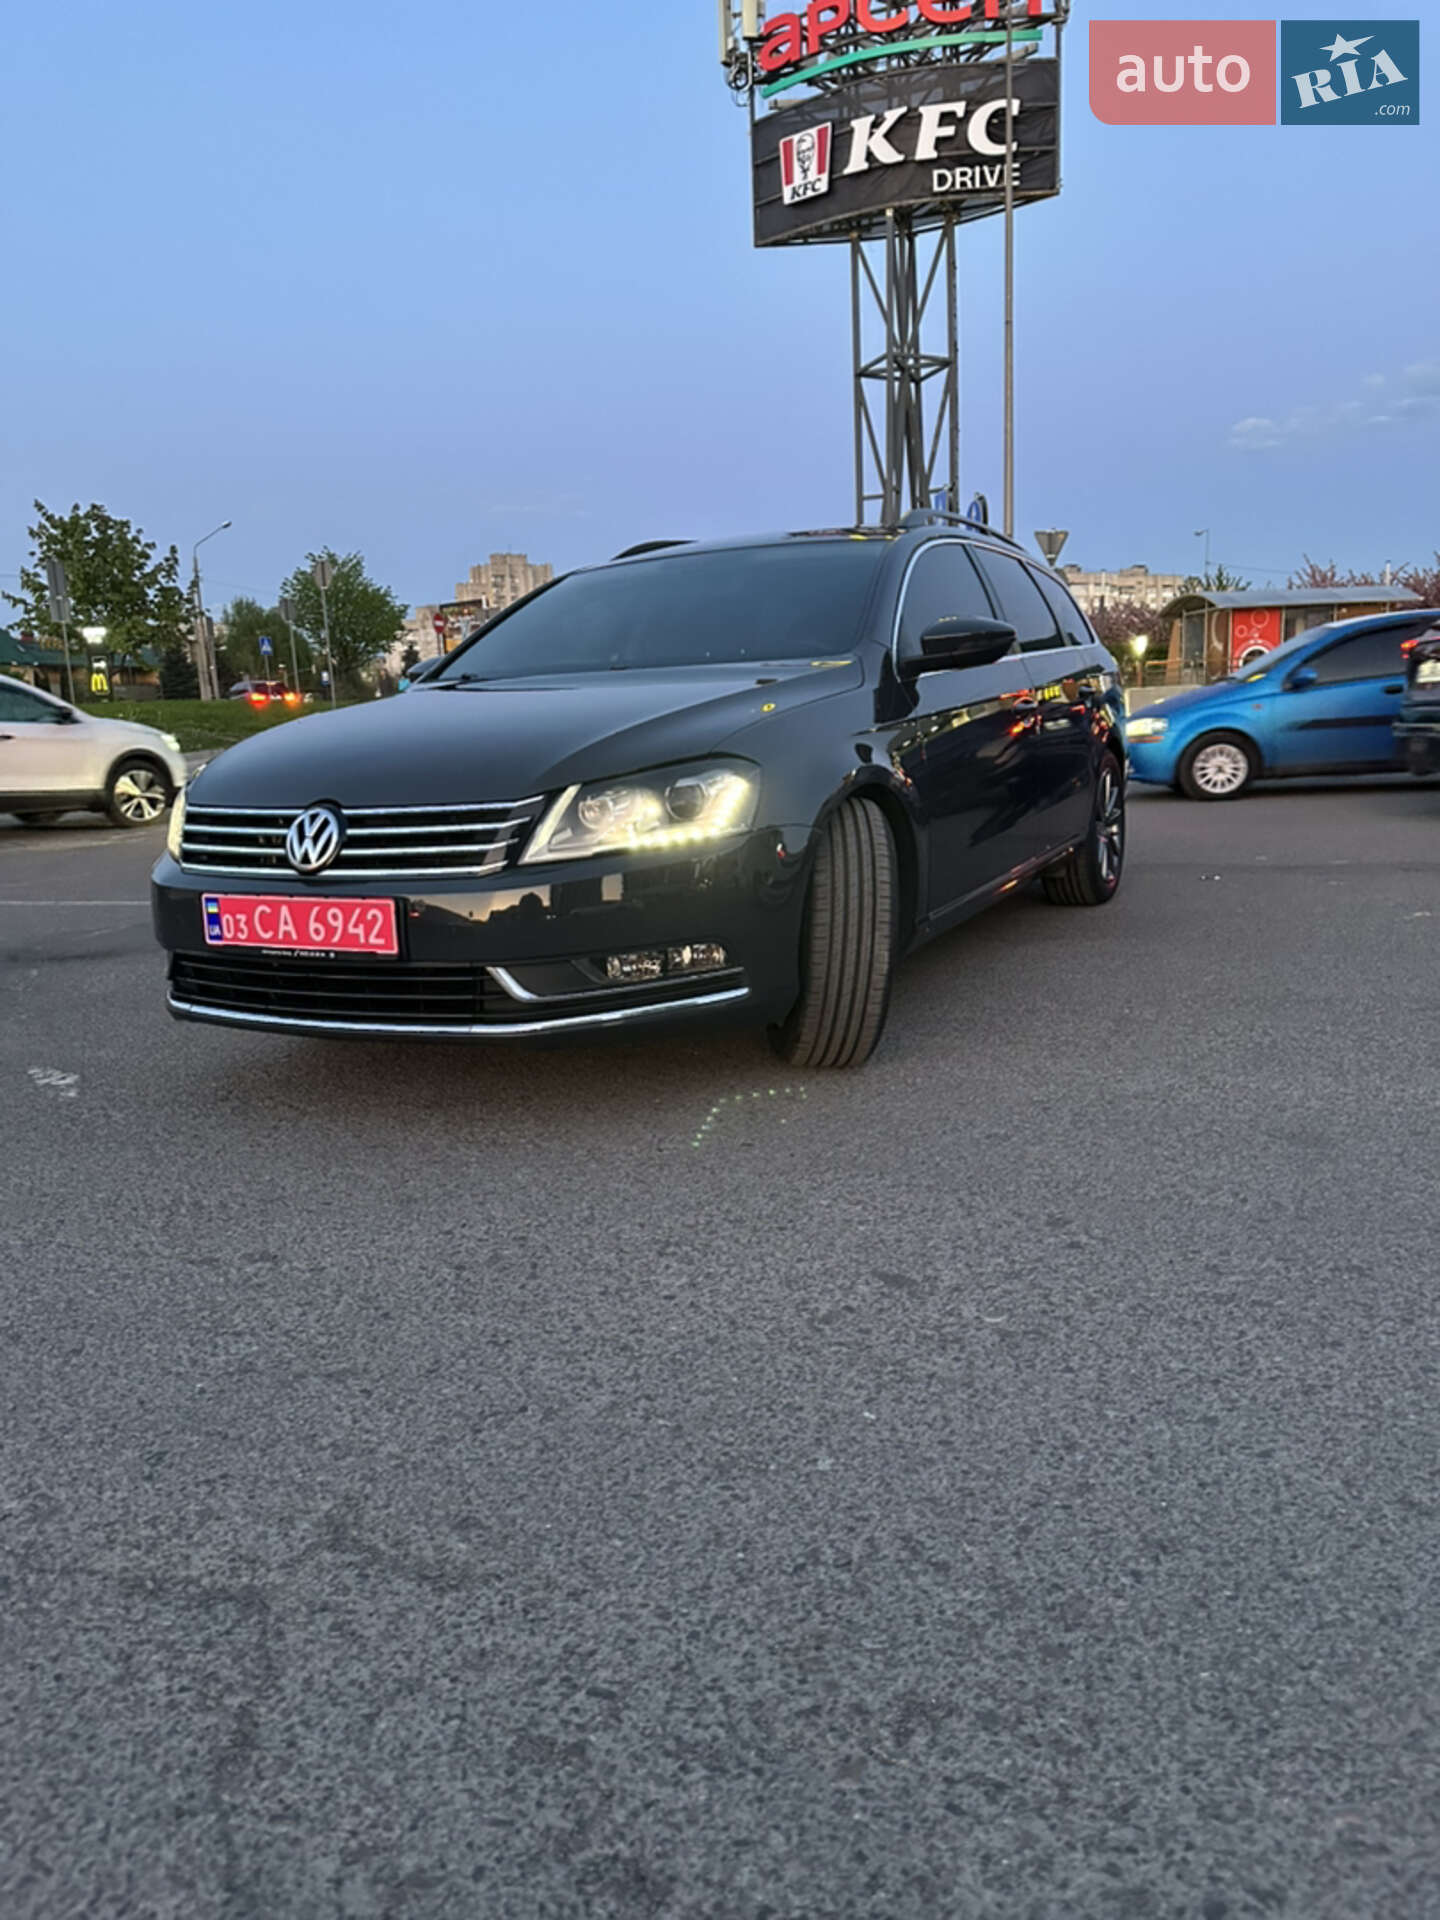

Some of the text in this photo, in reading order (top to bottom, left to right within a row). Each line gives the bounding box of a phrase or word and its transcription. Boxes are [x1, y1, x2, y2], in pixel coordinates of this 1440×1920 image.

[842, 98, 1021, 175] KFC
[790, 177, 822, 201] KFC
[932, 162, 1021, 193] DRIVE
[222, 904, 385, 945] 03 CA 6942
